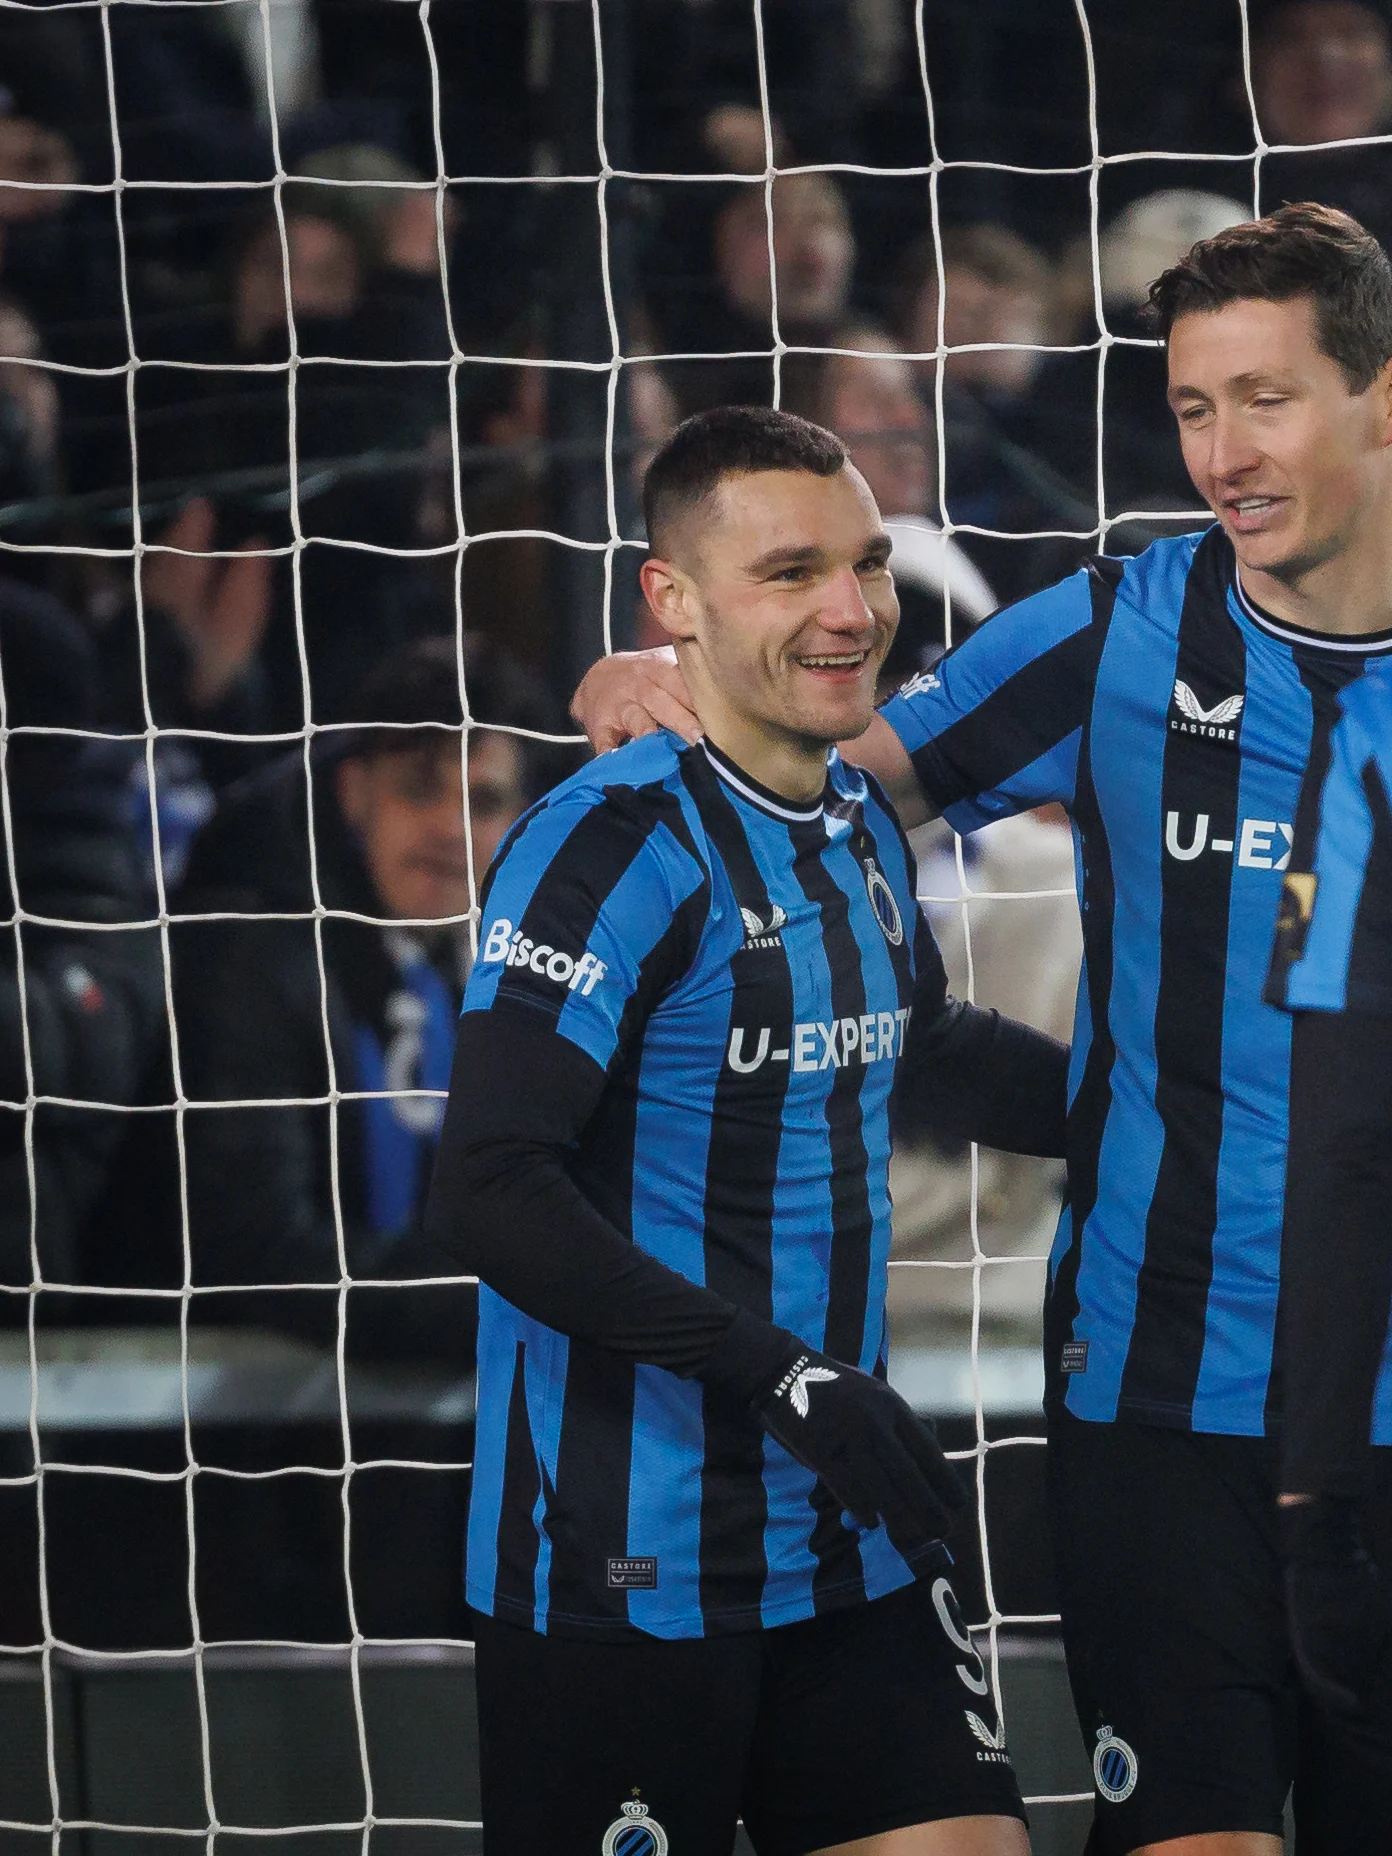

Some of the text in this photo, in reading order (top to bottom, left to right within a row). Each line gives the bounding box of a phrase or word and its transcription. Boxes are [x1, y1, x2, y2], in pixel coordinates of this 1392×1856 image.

[1171, 720, 1236, 741] CASTORE
[483, 919, 609, 997] Biscoff
[728, 1006, 912, 1073] U-EXPERT
[773, 1355, 809, 1397] CASTORE
